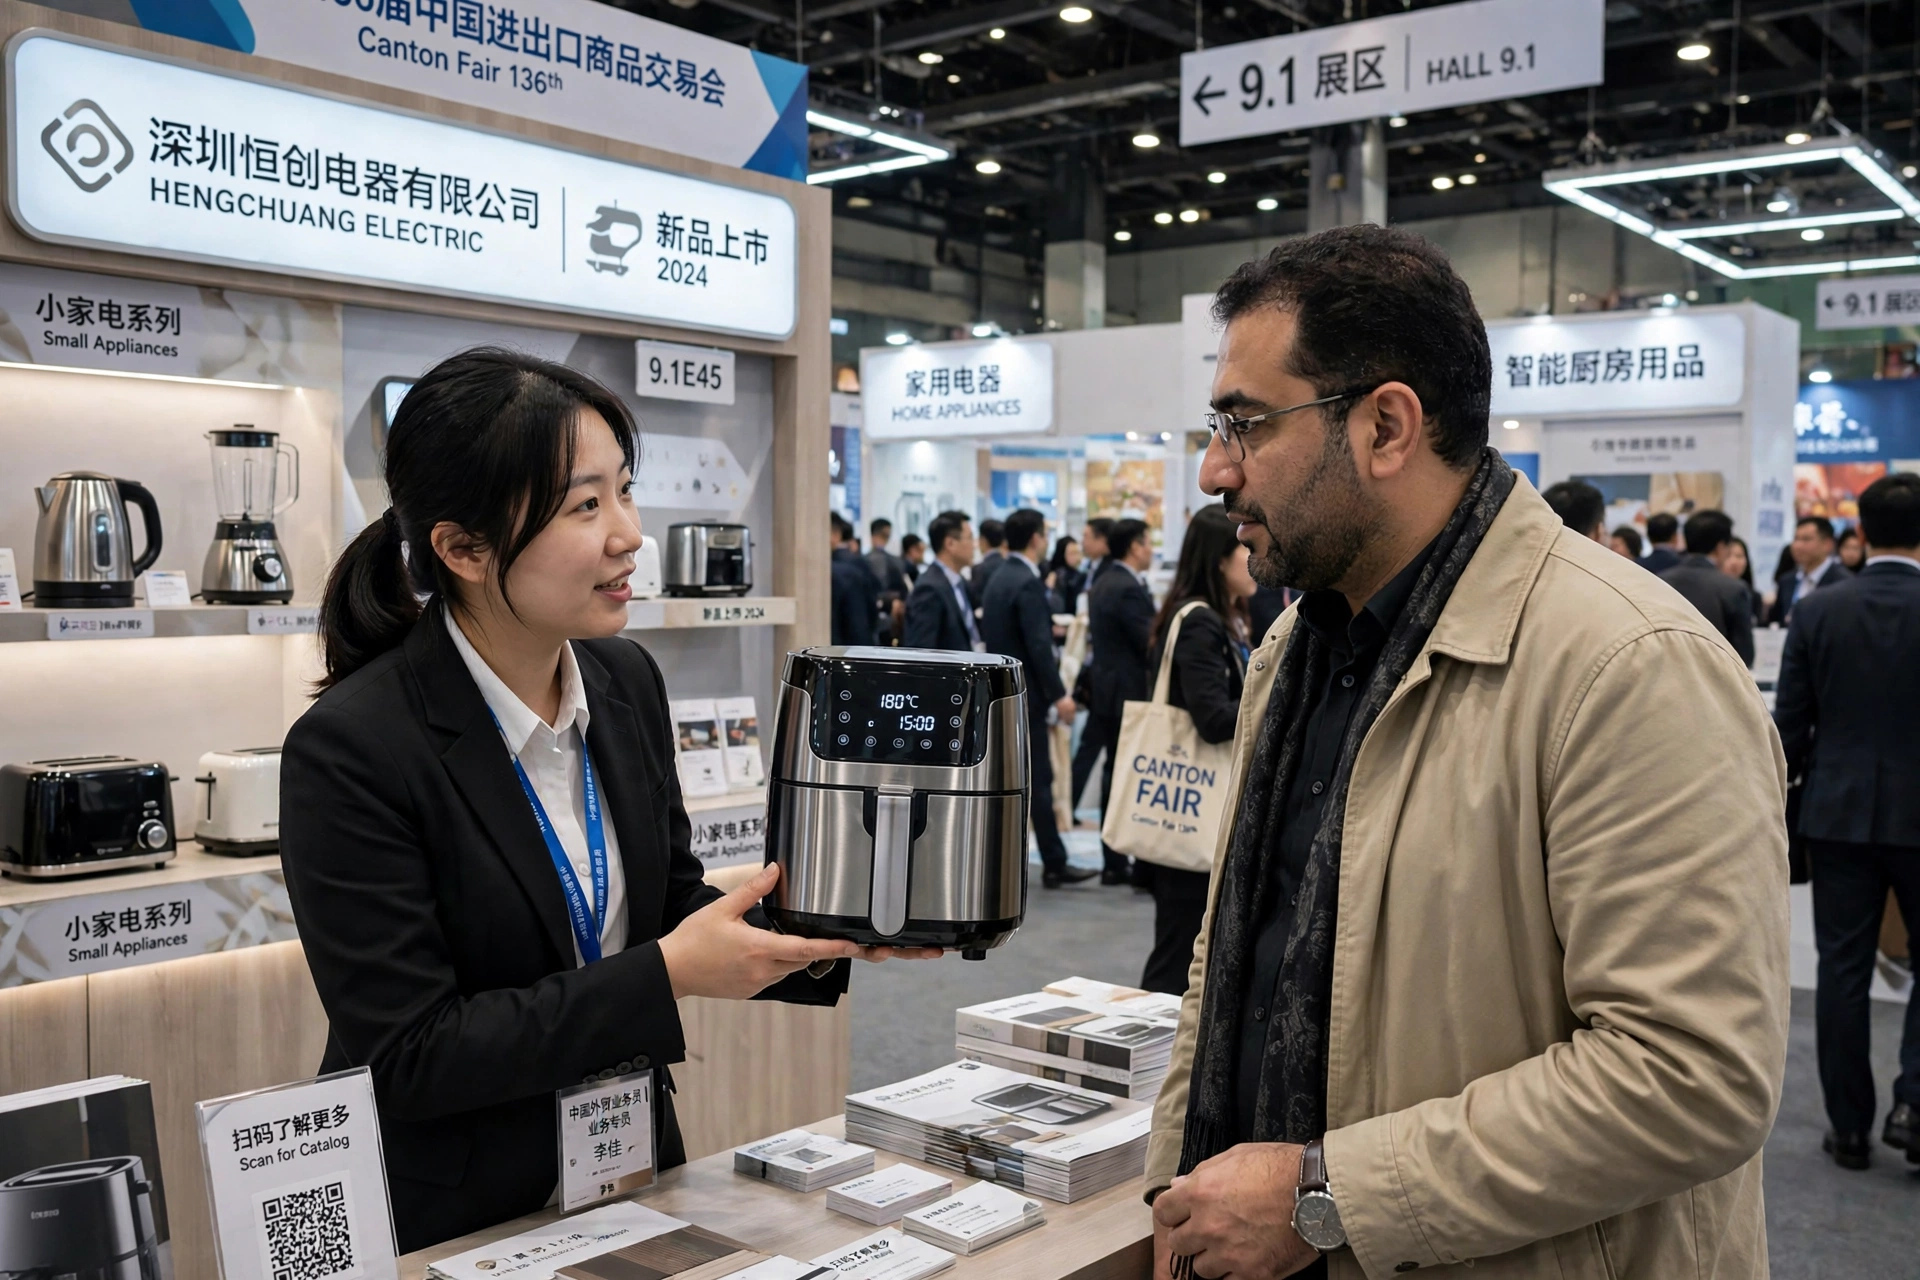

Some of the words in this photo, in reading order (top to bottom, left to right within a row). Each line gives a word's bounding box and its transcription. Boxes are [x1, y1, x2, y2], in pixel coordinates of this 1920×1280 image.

[321, 0, 726, 108] 届中国进出口商品交易会
[357, 26, 449, 71] Canton
[457, 51, 501, 82] Fair
[509, 64, 563, 94] 136th
[1427, 51, 1492, 85] HALL
[1500, 43, 1535, 73] 9.1
[1240, 57, 1297, 111] 9.1
[1314, 45, 1387, 98] 展区
[149, 116, 540, 230] 深圳恒创电器有限公司
[150, 177, 356, 233] HENGCHUANG
[365, 214, 484, 253] ELECTRIC
[656, 211, 769, 266] 新品上市
[657, 257, 708, 287] 2024
[35, 293, 181, 336] 小家电系列
[1843, 291, 1877, 317] 9.1
[43, 330, 88, 349] Small
[93, 335, 178, 358] Appliances
[649, 356, 722, 390] 9.1E45
[905, 364, 1001, 398] 家用电器
[1506, 344, 1704, 388] 智能厨房用品
[891, 405, 934, 422] HOME
[937, 399, 1022, 418] APPLIANCES
[900, 714, 935, 731] 15:00
[1133, 755, 1216, 788] CANTON
[1136, 778, 1203, 818] FAIR
[65, 899, 191, 942] 小家电系列
[69, 943, 108, 962] Small
[113, 934, 188, 958] Appliances
[232, 1103, 351, 1152] 扫码了解更多
[239, 1152, 274, 1171] Scan
[277, 1148, 296, 1163] for
[299, 1135, 350, 1156] Catalog
[593, 1139, 622, 1162] 李佳
